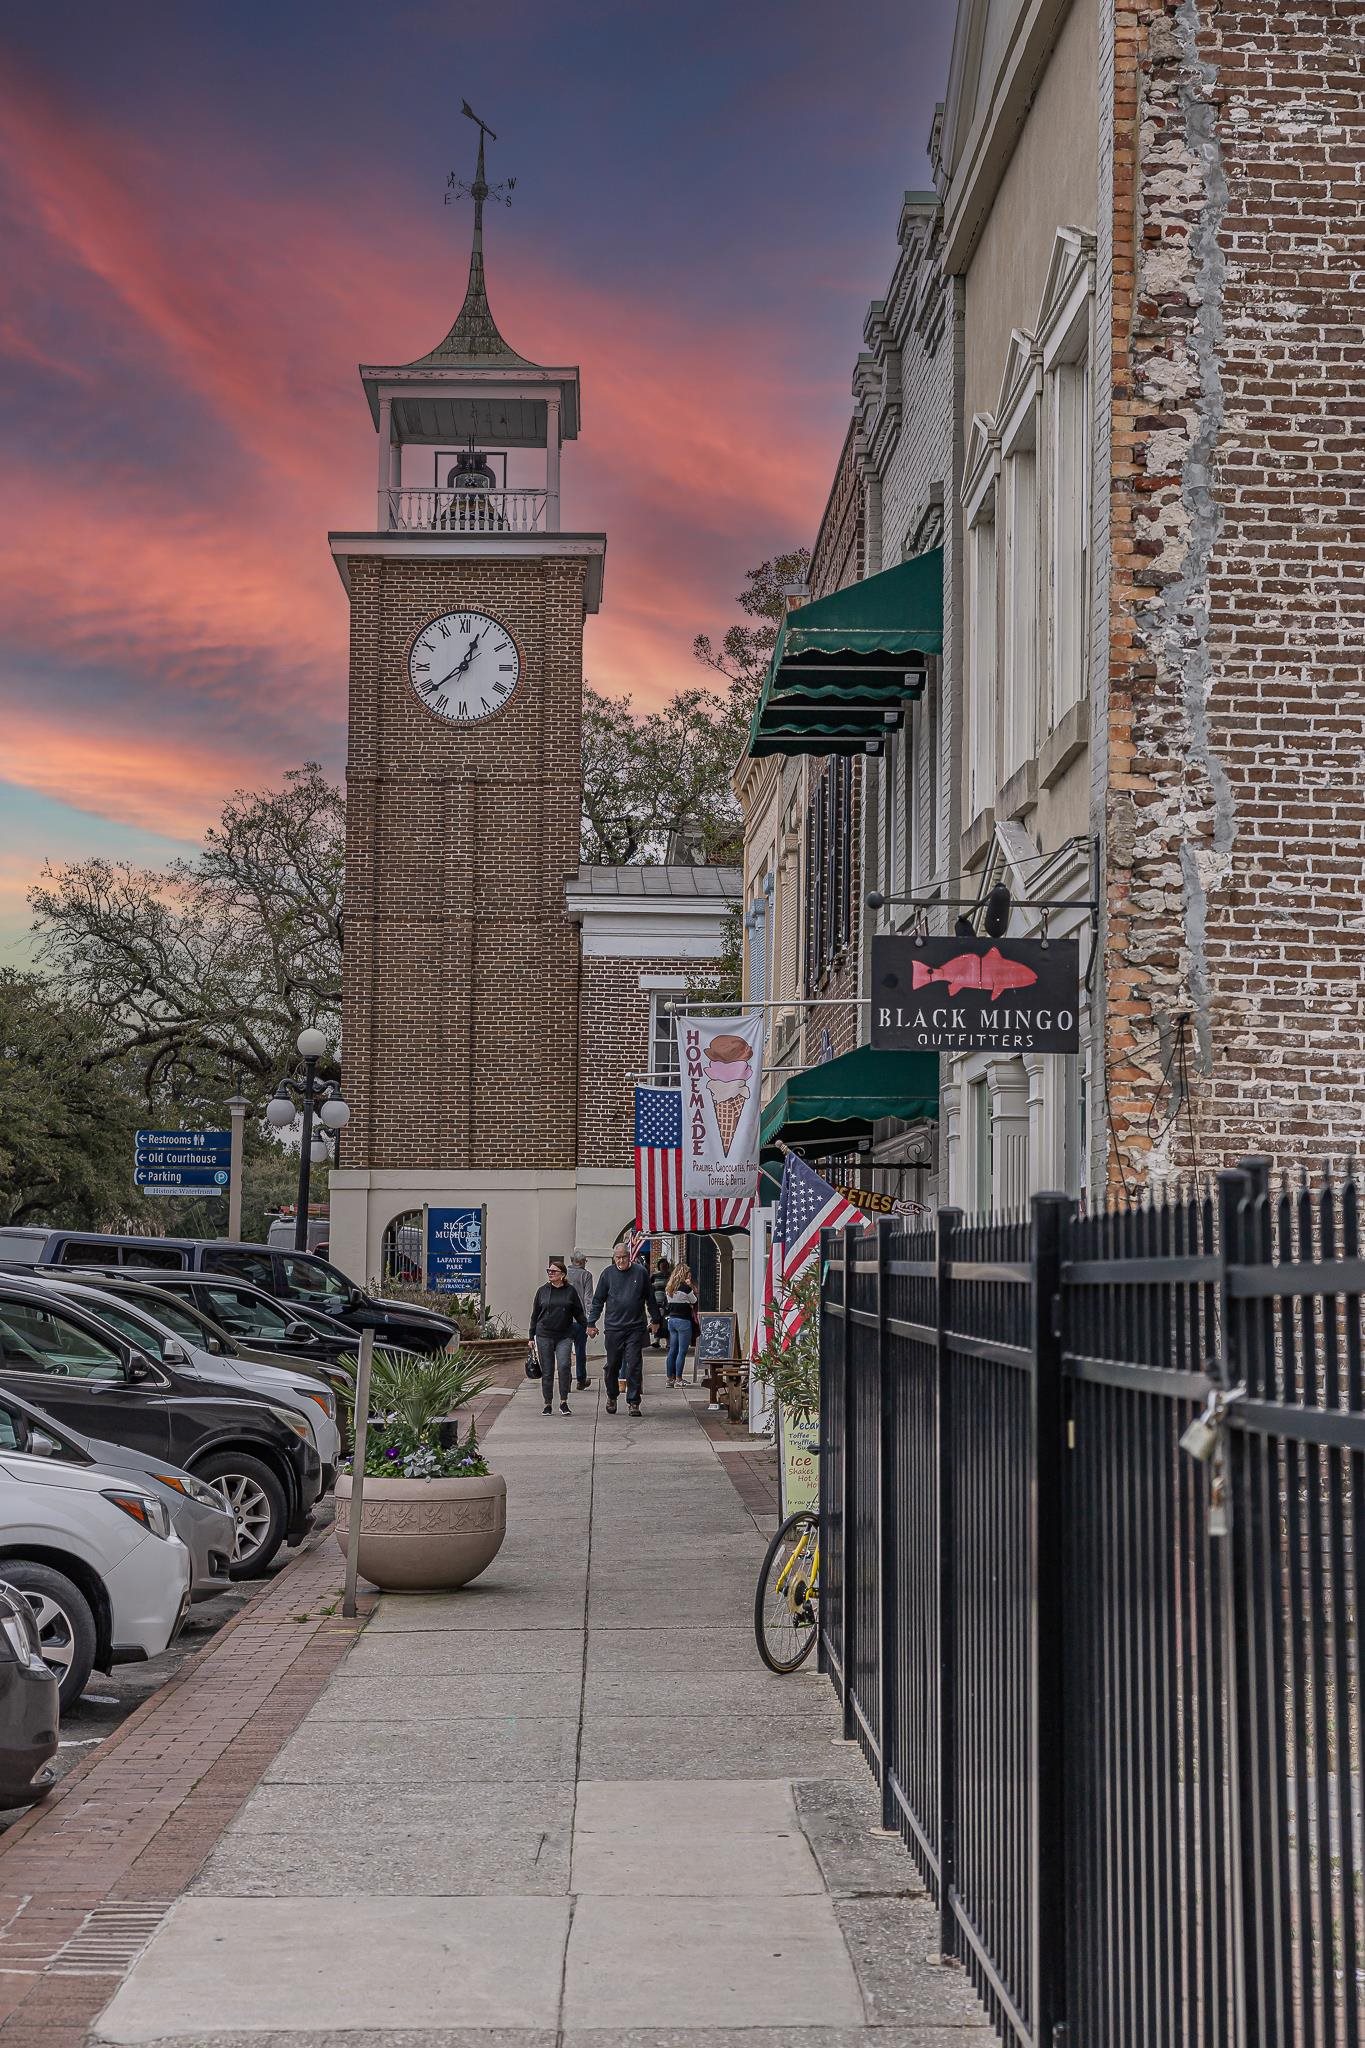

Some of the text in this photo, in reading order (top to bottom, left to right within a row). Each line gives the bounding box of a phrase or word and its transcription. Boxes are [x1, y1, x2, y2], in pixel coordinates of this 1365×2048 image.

[460, 619, 471, 633] XII
[878, 1008, 1073, 1030] BLACK MINGO
[917, 1033, 1034, 1047] OUTFITTERS
[685, 1030, 706, 1156] HOMEMADE
[148, 1134, 192, 1144] Restrooms
[148, 1152, 217, 1164] Old Courthouse
[148, 1171, 182, 1184] Parking
[837, 1187, 892, 1212] EETIES
[443, 1222, 464, 1230] RICE
[435, 1231, 472, 1239] MUSEUM
[790, 1455, 812, 1467] Ice
[788, 1467, 813, 1475] Shakes
